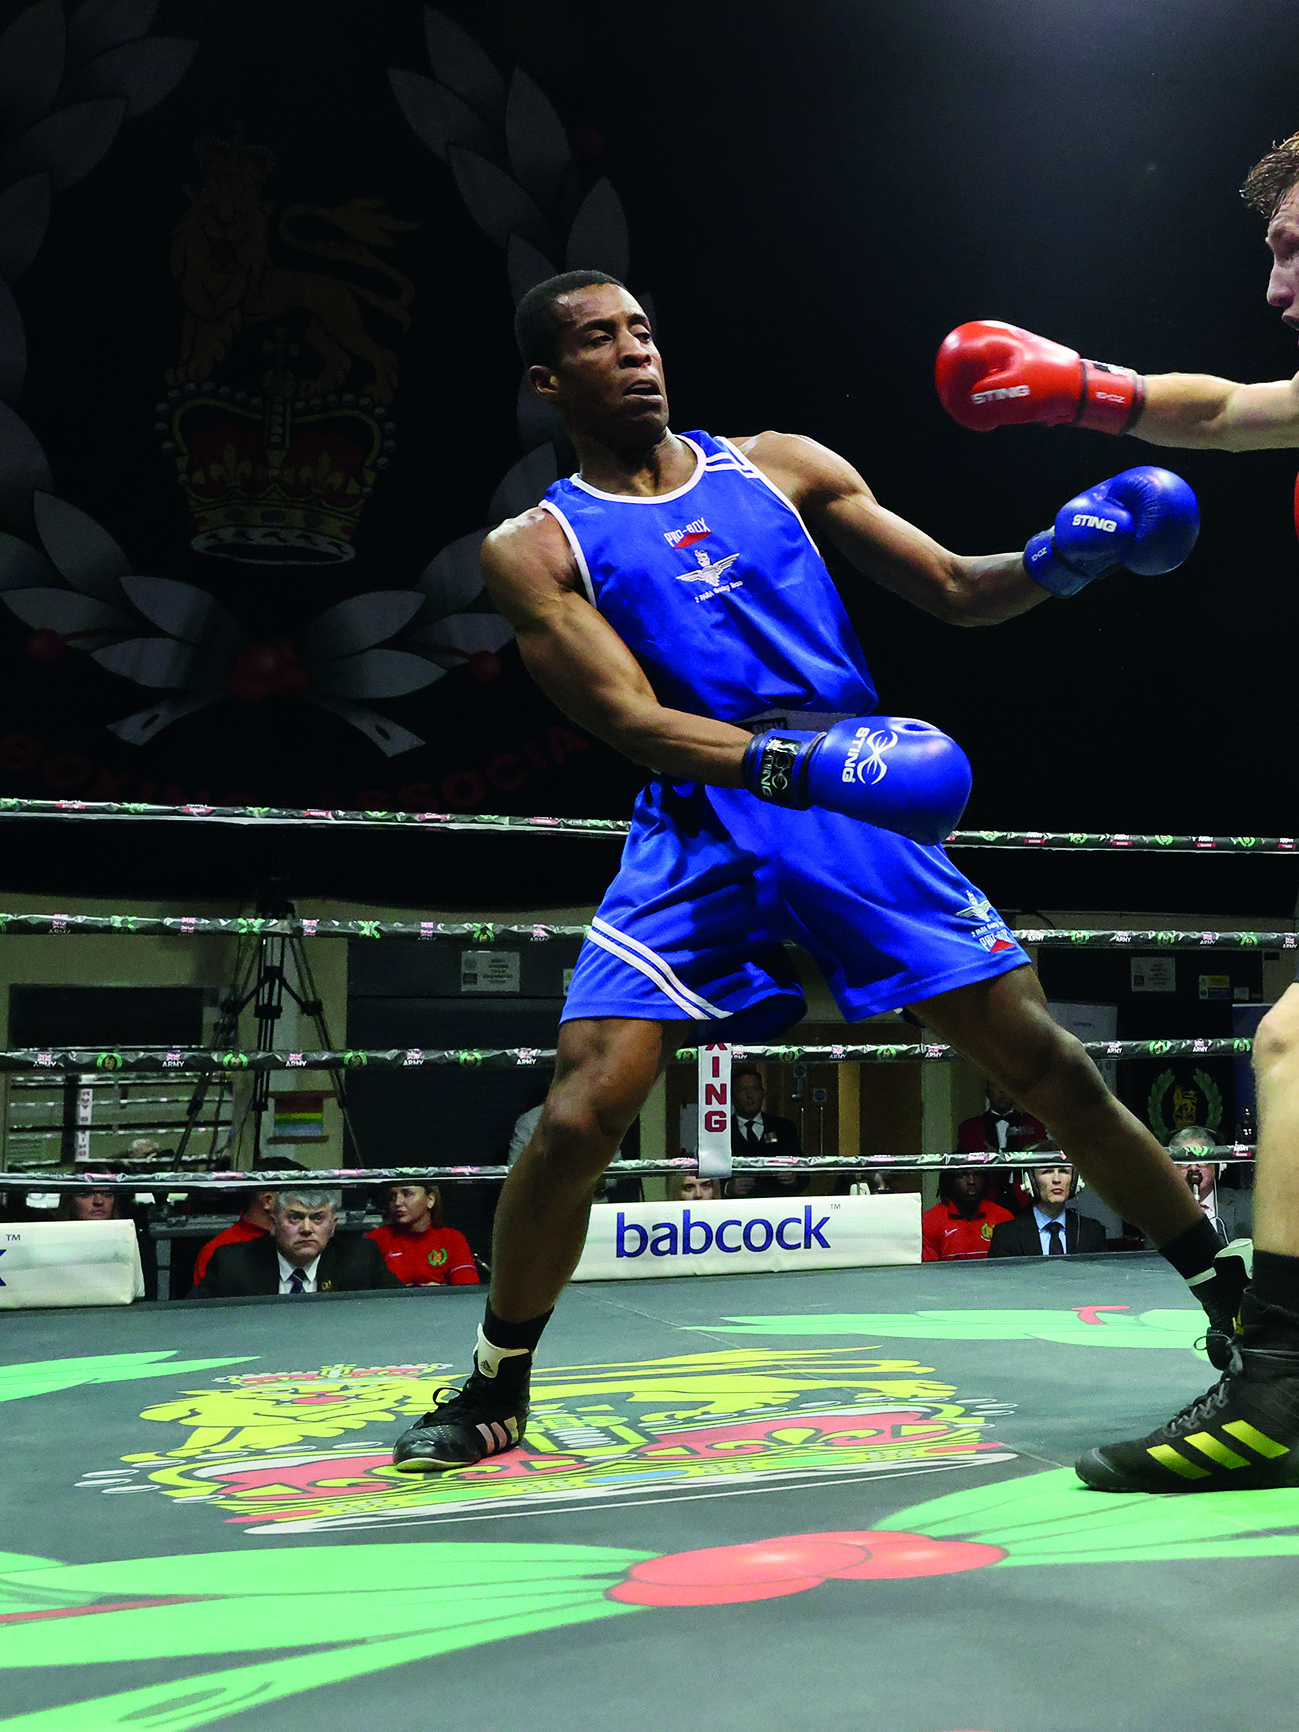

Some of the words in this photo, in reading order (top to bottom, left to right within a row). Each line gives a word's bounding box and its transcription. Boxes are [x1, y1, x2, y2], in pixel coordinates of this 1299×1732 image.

[971, 385, 1031, 404] STING
[663, 517, 711, 548] PRO-BOX
[1072, 514, 1117, 533] STING
[841, 727, 871, 783] STING
[616, 1205, 831, 1258] babcock
